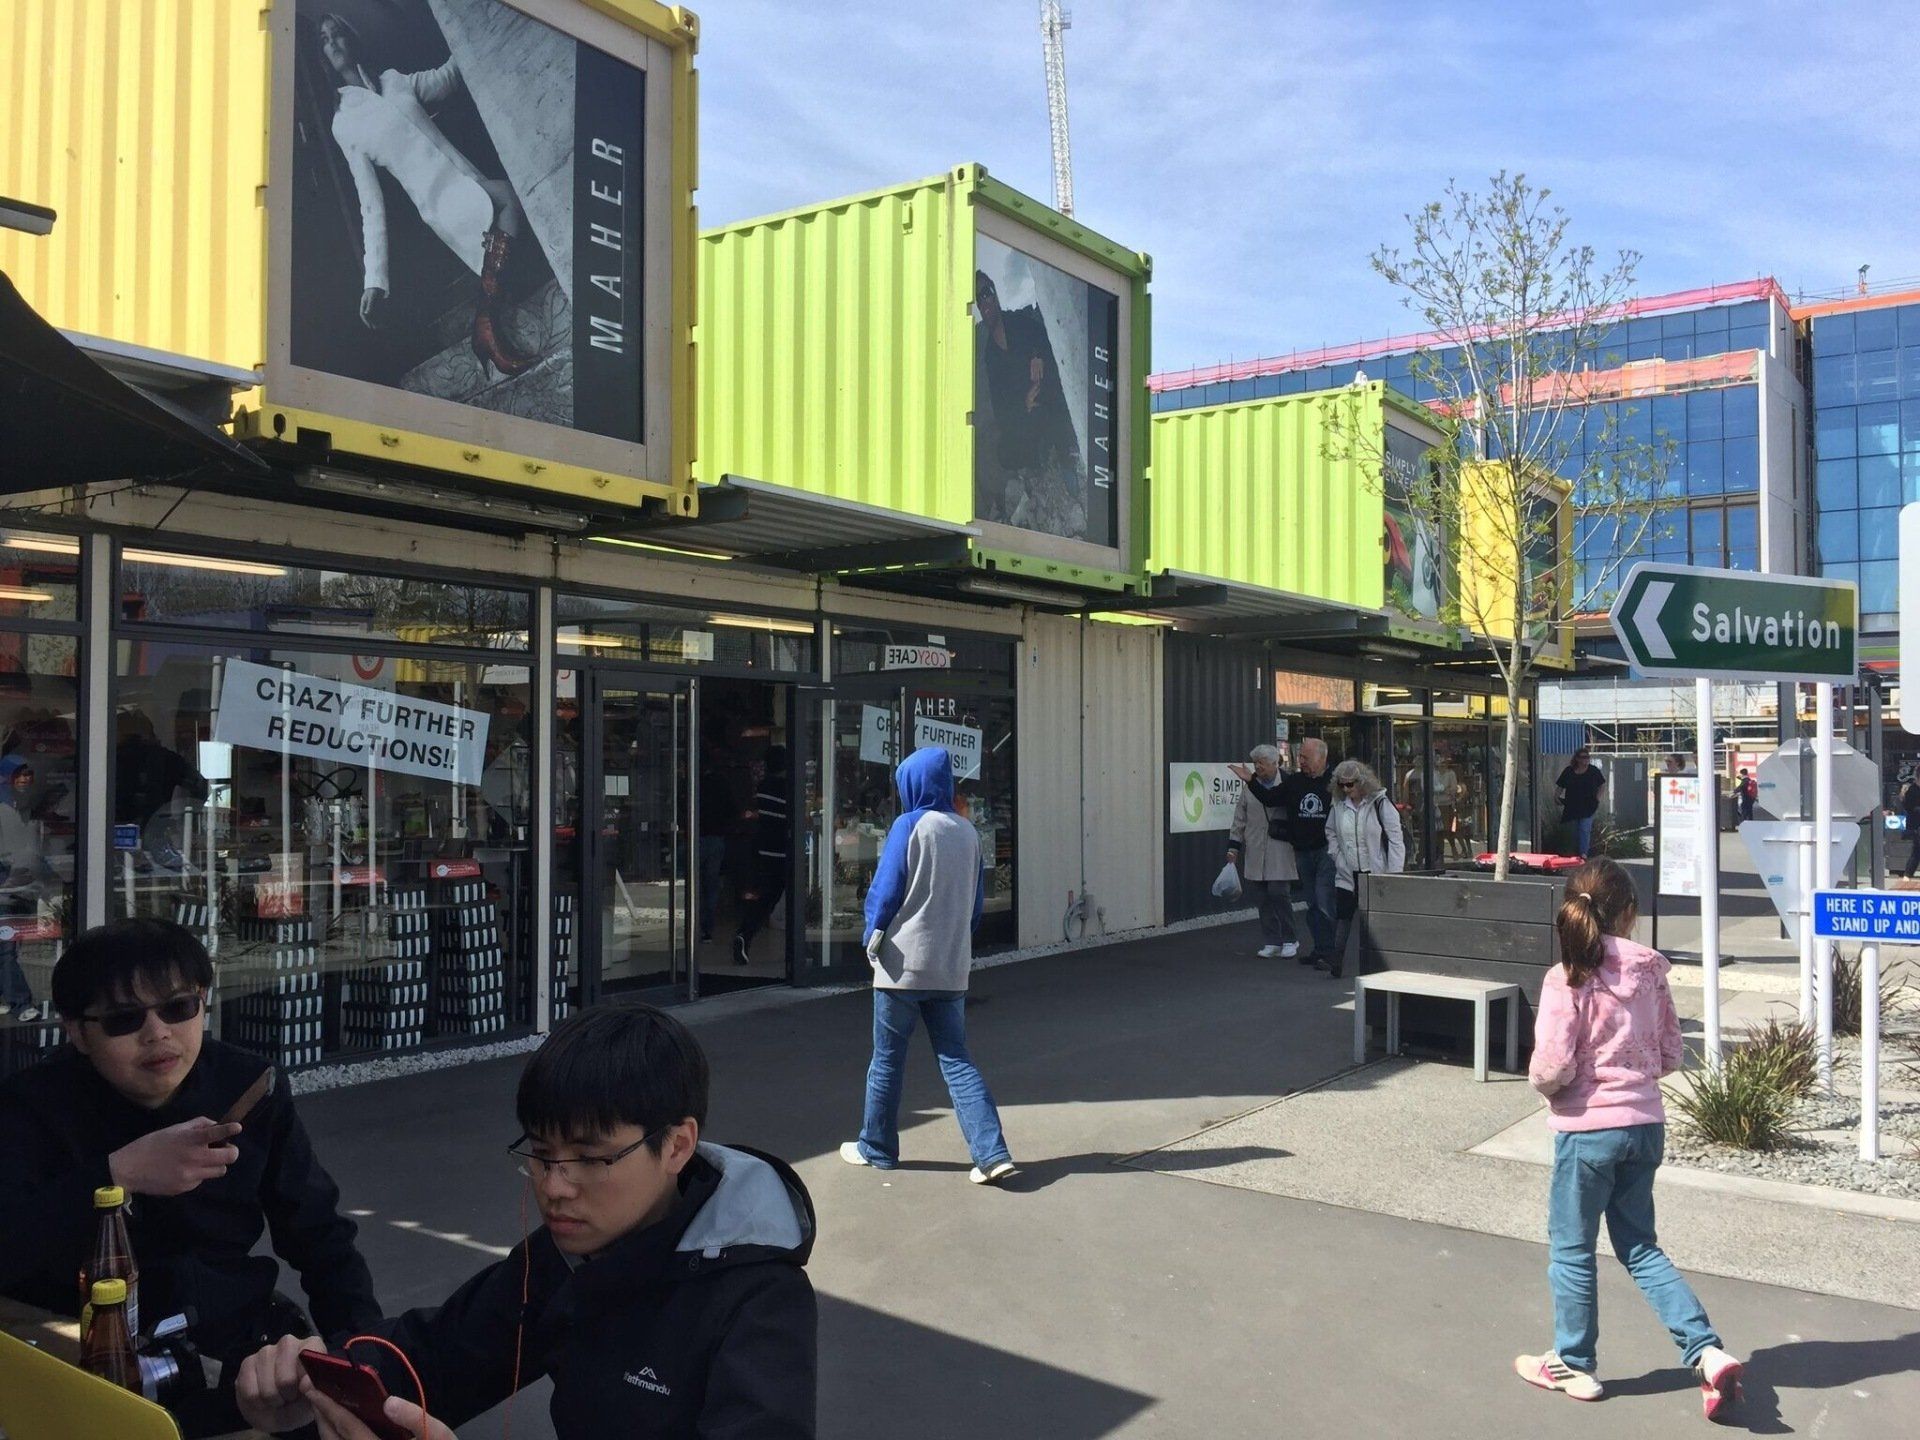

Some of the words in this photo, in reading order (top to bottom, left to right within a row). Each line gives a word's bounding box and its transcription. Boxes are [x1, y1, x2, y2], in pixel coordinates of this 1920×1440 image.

[590, 138, 623, 354] MAHER
[1094, 346, 1109, 489] MAHER
[1385, 450, 1417, 476] SIMPLY
[1691, 602, 1841, 650] Salvation
[256, 677, 352, 716] CRAZY
[360, 698, 475, 741] FURTHER
[914, 698, 957, 717] AHER
[267, 715, 457, 770] REDUCTIONS!!
[922, 725, 976, 750] FURTHER
[1213, 777, 1244, 793] SIMP
[1826, 897, 1857, 913] HERE
[1862, 899, 1874, 914] IS
[1880, 900, 1896, 915] AN
[1832, 916, 1868, 933] STAND
[1874, 919, 1890, 933] UP
[1895, 920, 1920, 935] AND
